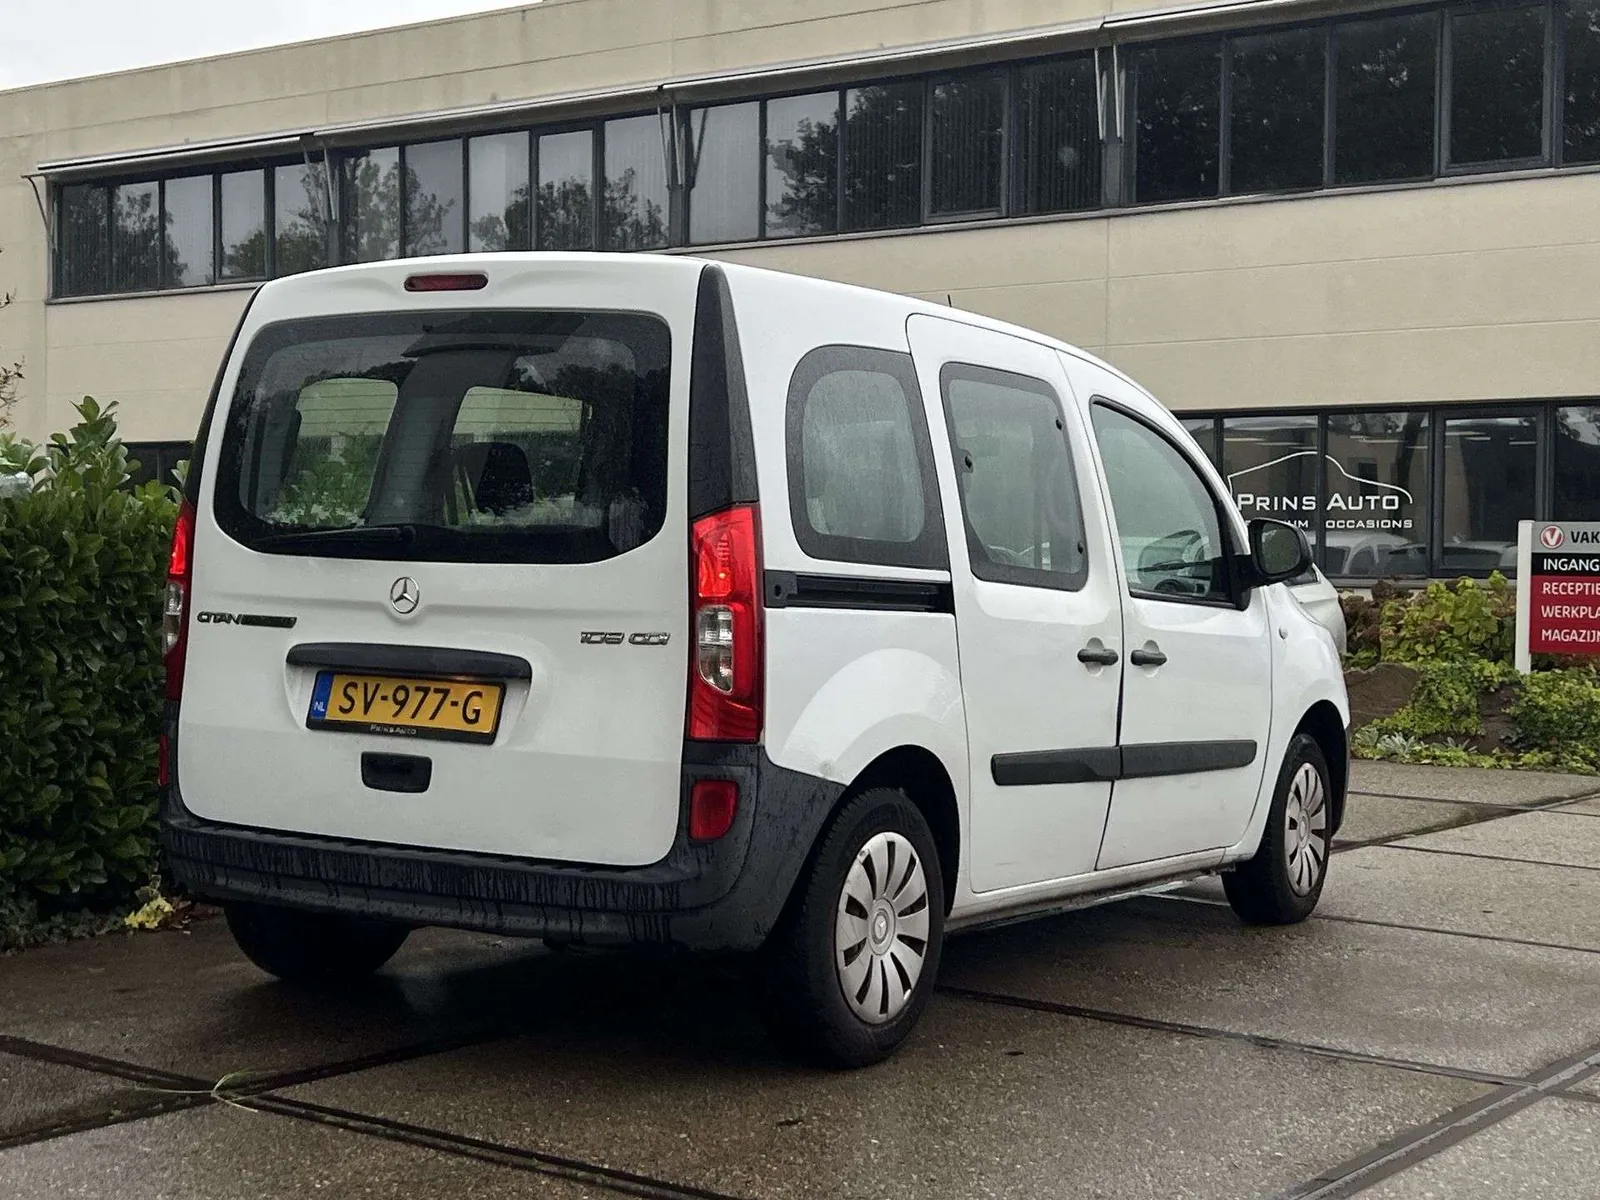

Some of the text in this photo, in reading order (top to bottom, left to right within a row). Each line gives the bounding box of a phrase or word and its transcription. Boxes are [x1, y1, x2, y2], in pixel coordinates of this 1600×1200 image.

[1237, 493, 1400, 511] PRINS AUTO
[1325, 519, 1413, 529] OCCASIONS
[1570, 531, 1600, 544] VAK
[1543, 558, 1600, 571] INGANG
[1542, 582, 1600, 596] RECEPTIE
[580, 631, 670, 646] 108 CDI
[313, 701, 325, 712] NL
[338, 681, 483, 725] SV-977-G
